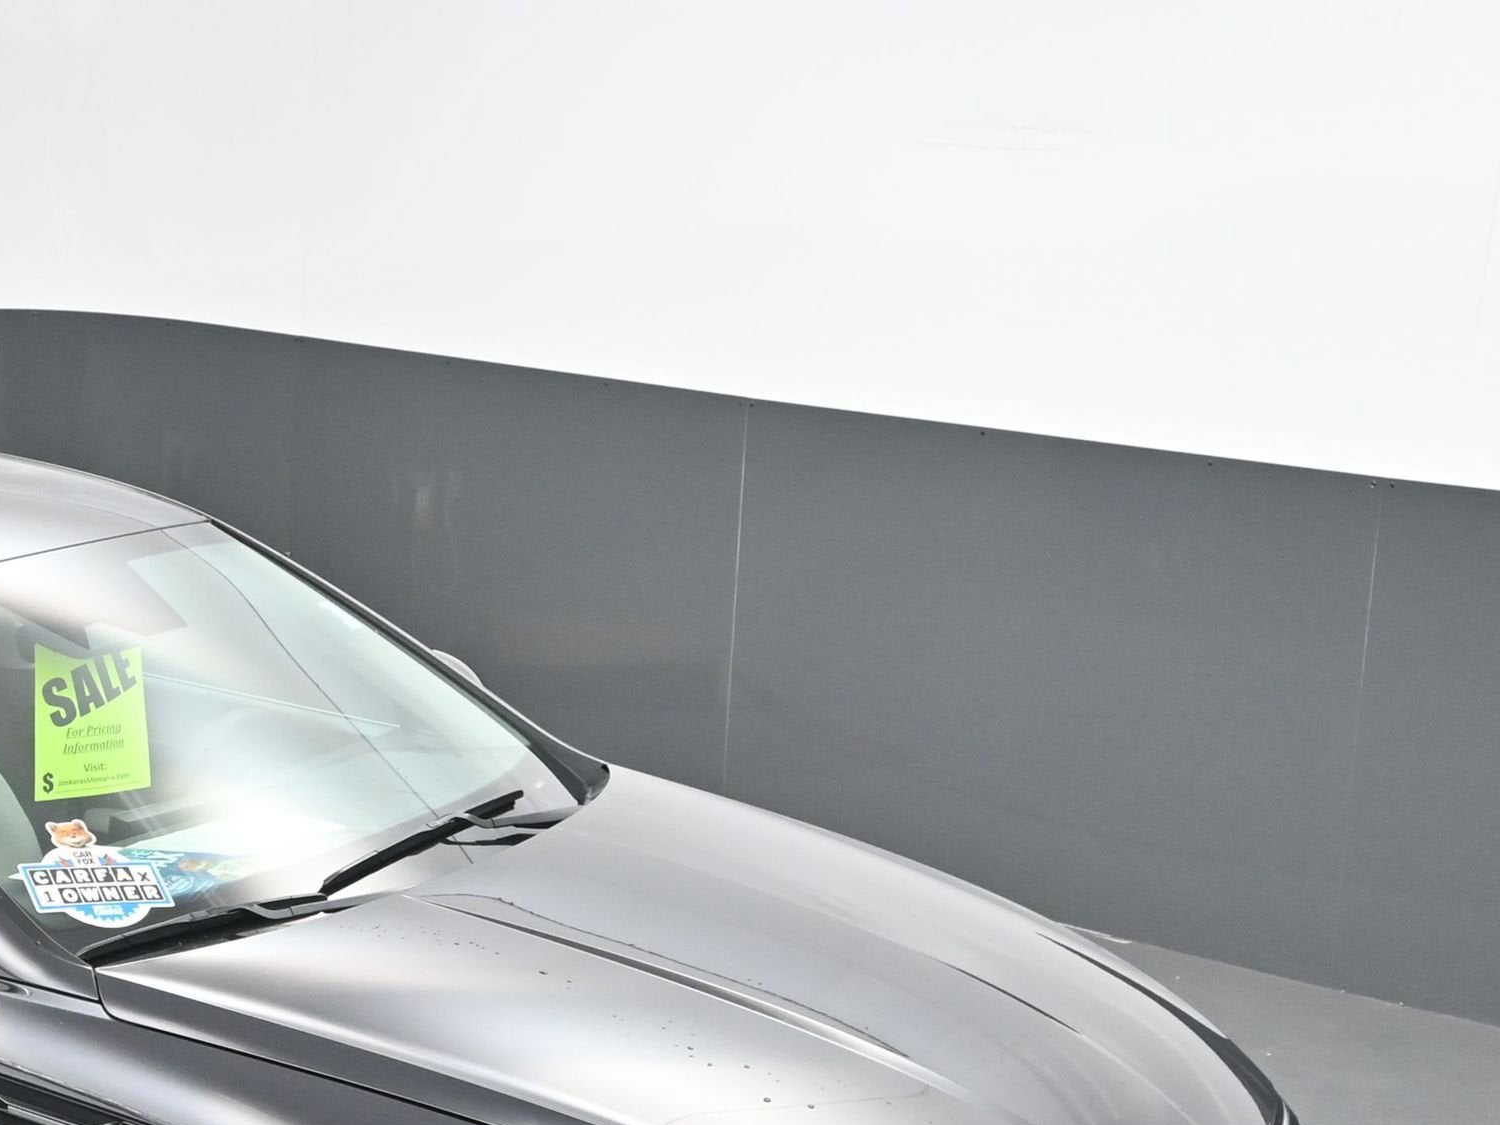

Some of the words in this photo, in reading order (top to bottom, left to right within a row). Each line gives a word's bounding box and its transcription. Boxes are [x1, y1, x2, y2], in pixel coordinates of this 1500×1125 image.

[42, 650, 137, 727] SALE
[66, 727, 84, 738] For
[86, 723, 122, 736] Pricing
[63, 738, 125, 755] Information
[84, 762, 108, 773] Visit:
[42, 772, 54, 793] $
[73, 851, 93, 859] CAR
[77, 857, 96, 866] FOX
[44, 890, 55, 902] 1
[59, 885, 164, 903] OWNER
